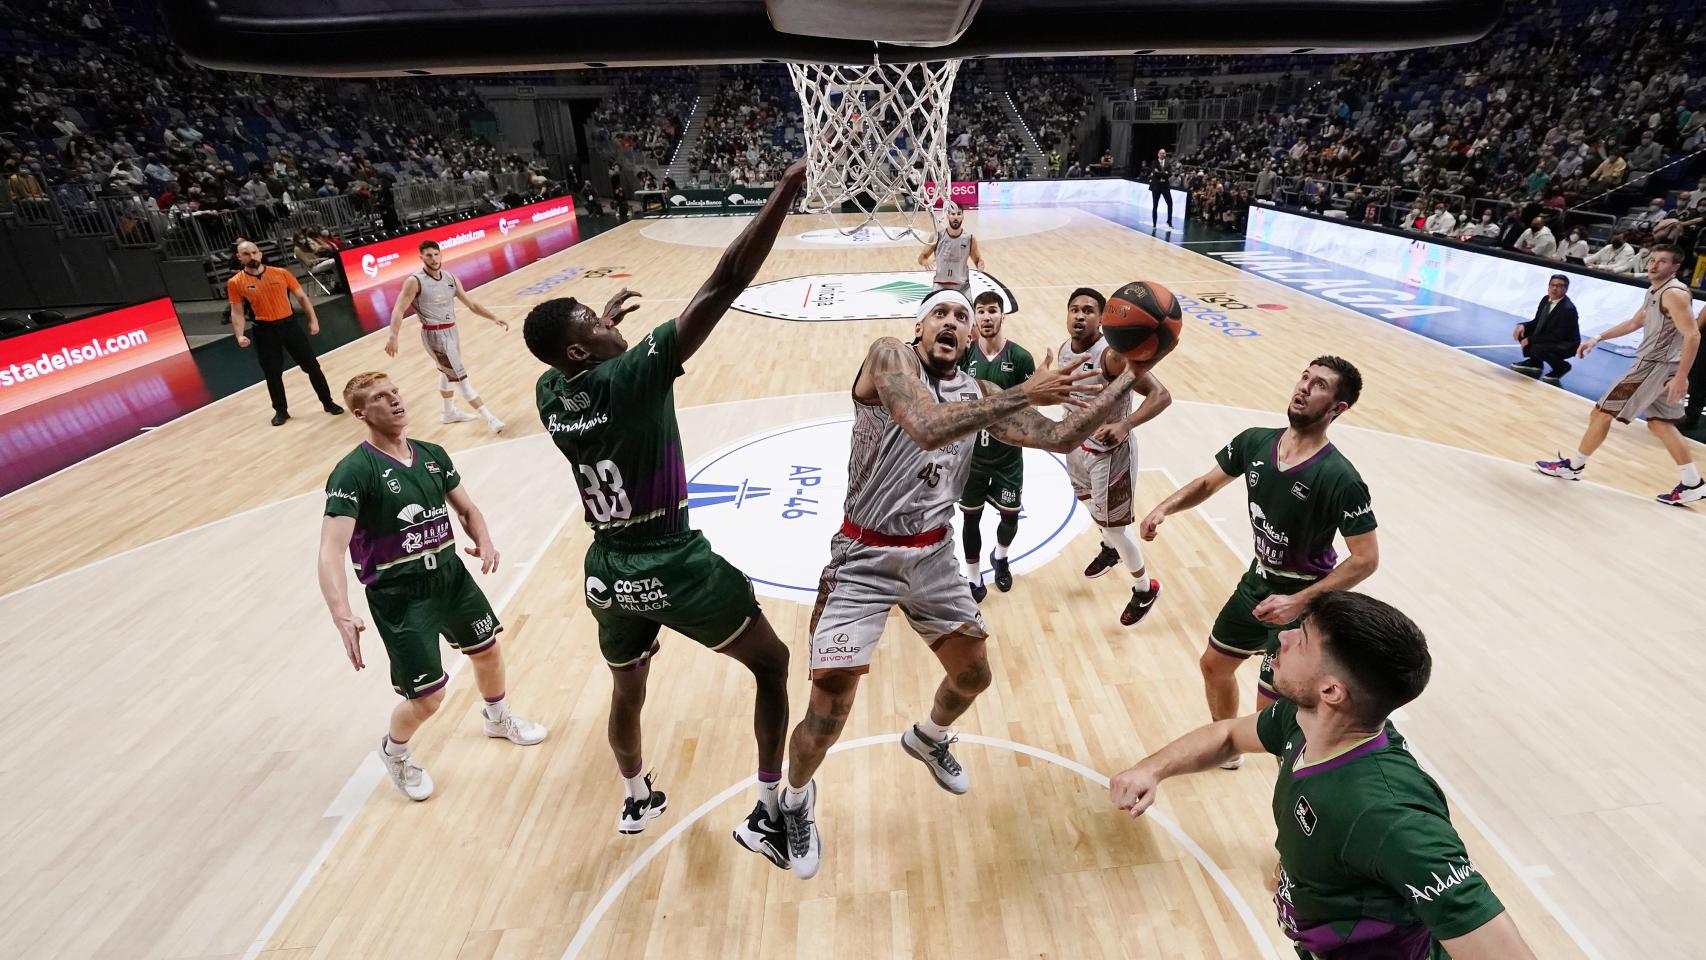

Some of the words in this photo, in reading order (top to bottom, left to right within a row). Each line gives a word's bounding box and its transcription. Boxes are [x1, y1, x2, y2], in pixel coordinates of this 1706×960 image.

[438, 229, 485, 250] costadelsol.com
[1196, 292, 1254, 310] liga
[0, 329, 149, 388] stadelsol.com
[980, 429, 990, 447] 8
[917, 462, 943, 489] 45
[578, 459, 633, 523] 33
[781, 465, 822, 520] AP-46
[423, 553, 438, 570] 0
[613, 577, 664, 594] COSTA
[615, 593, 640, 604] DEL
[640, 589, 668, 603] SOL
[818, 646, 862, 655] LEXUS
